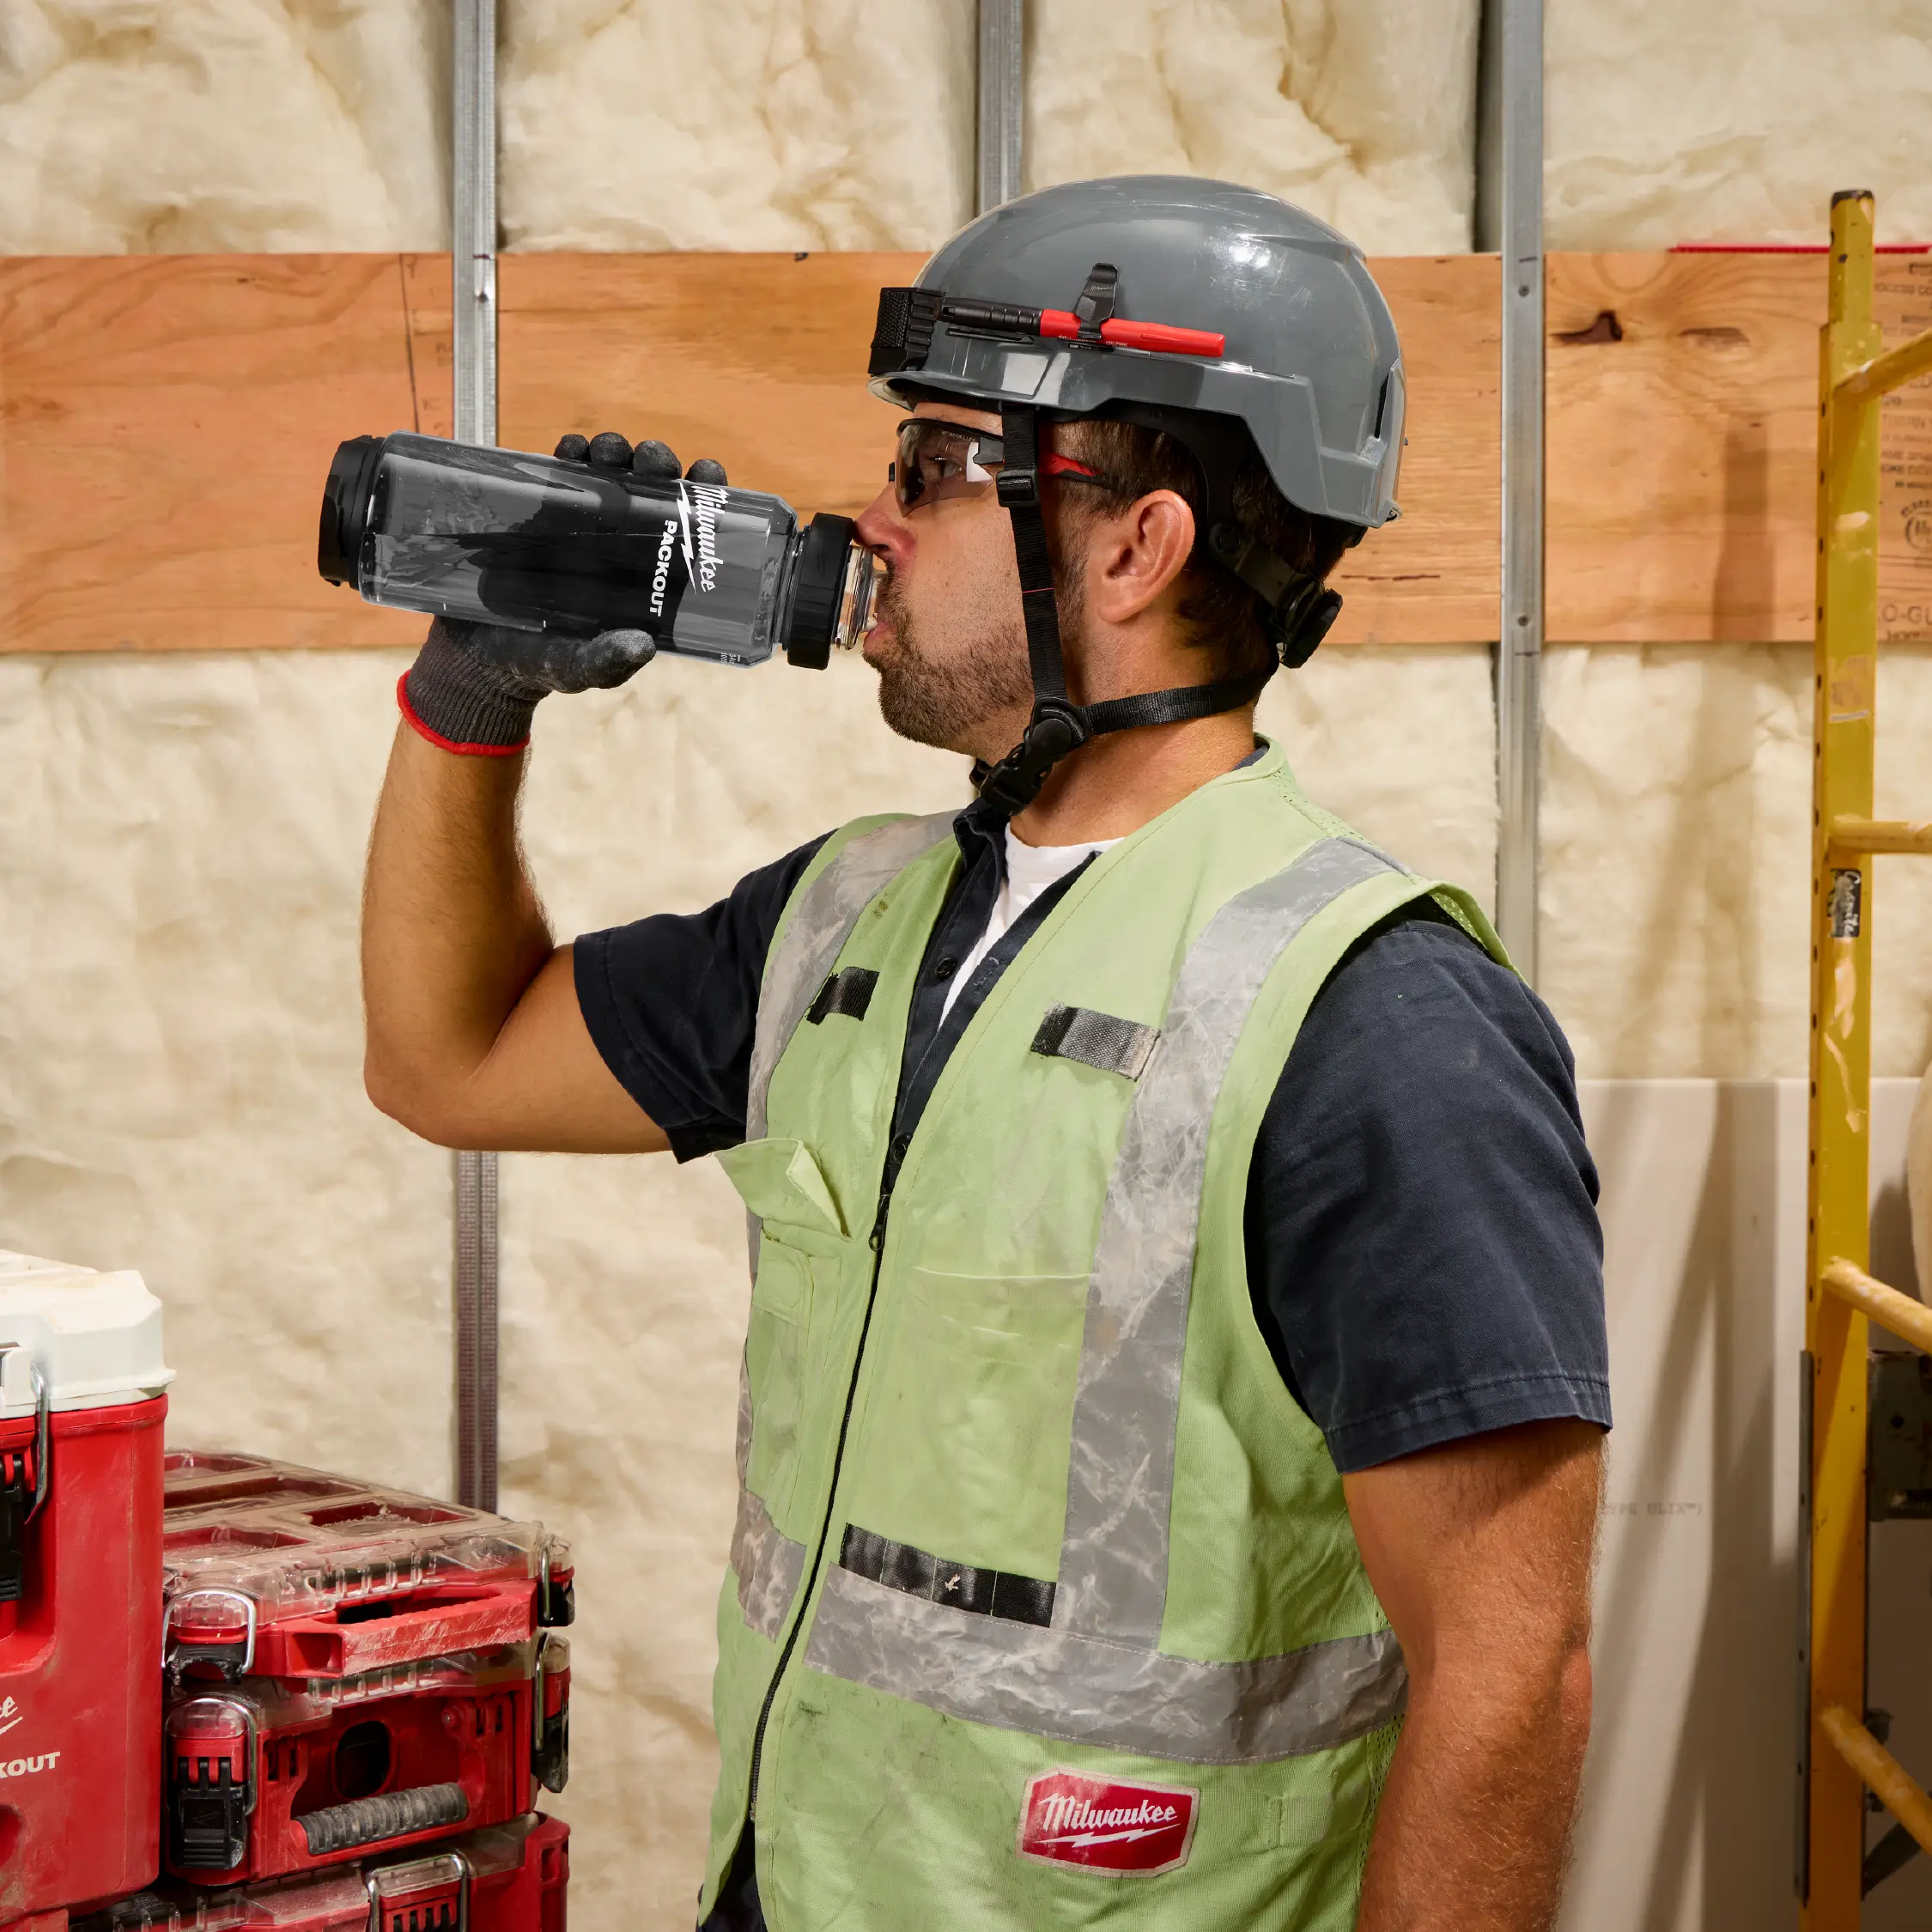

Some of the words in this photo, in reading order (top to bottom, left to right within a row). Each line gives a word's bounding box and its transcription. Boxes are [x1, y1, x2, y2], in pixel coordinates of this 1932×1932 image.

[649, 519, 678, 617] PACKOUT
[691, 485, 731, 592] Milwaukee
[1036, 1792, 1178, 1832] Milwaukee
